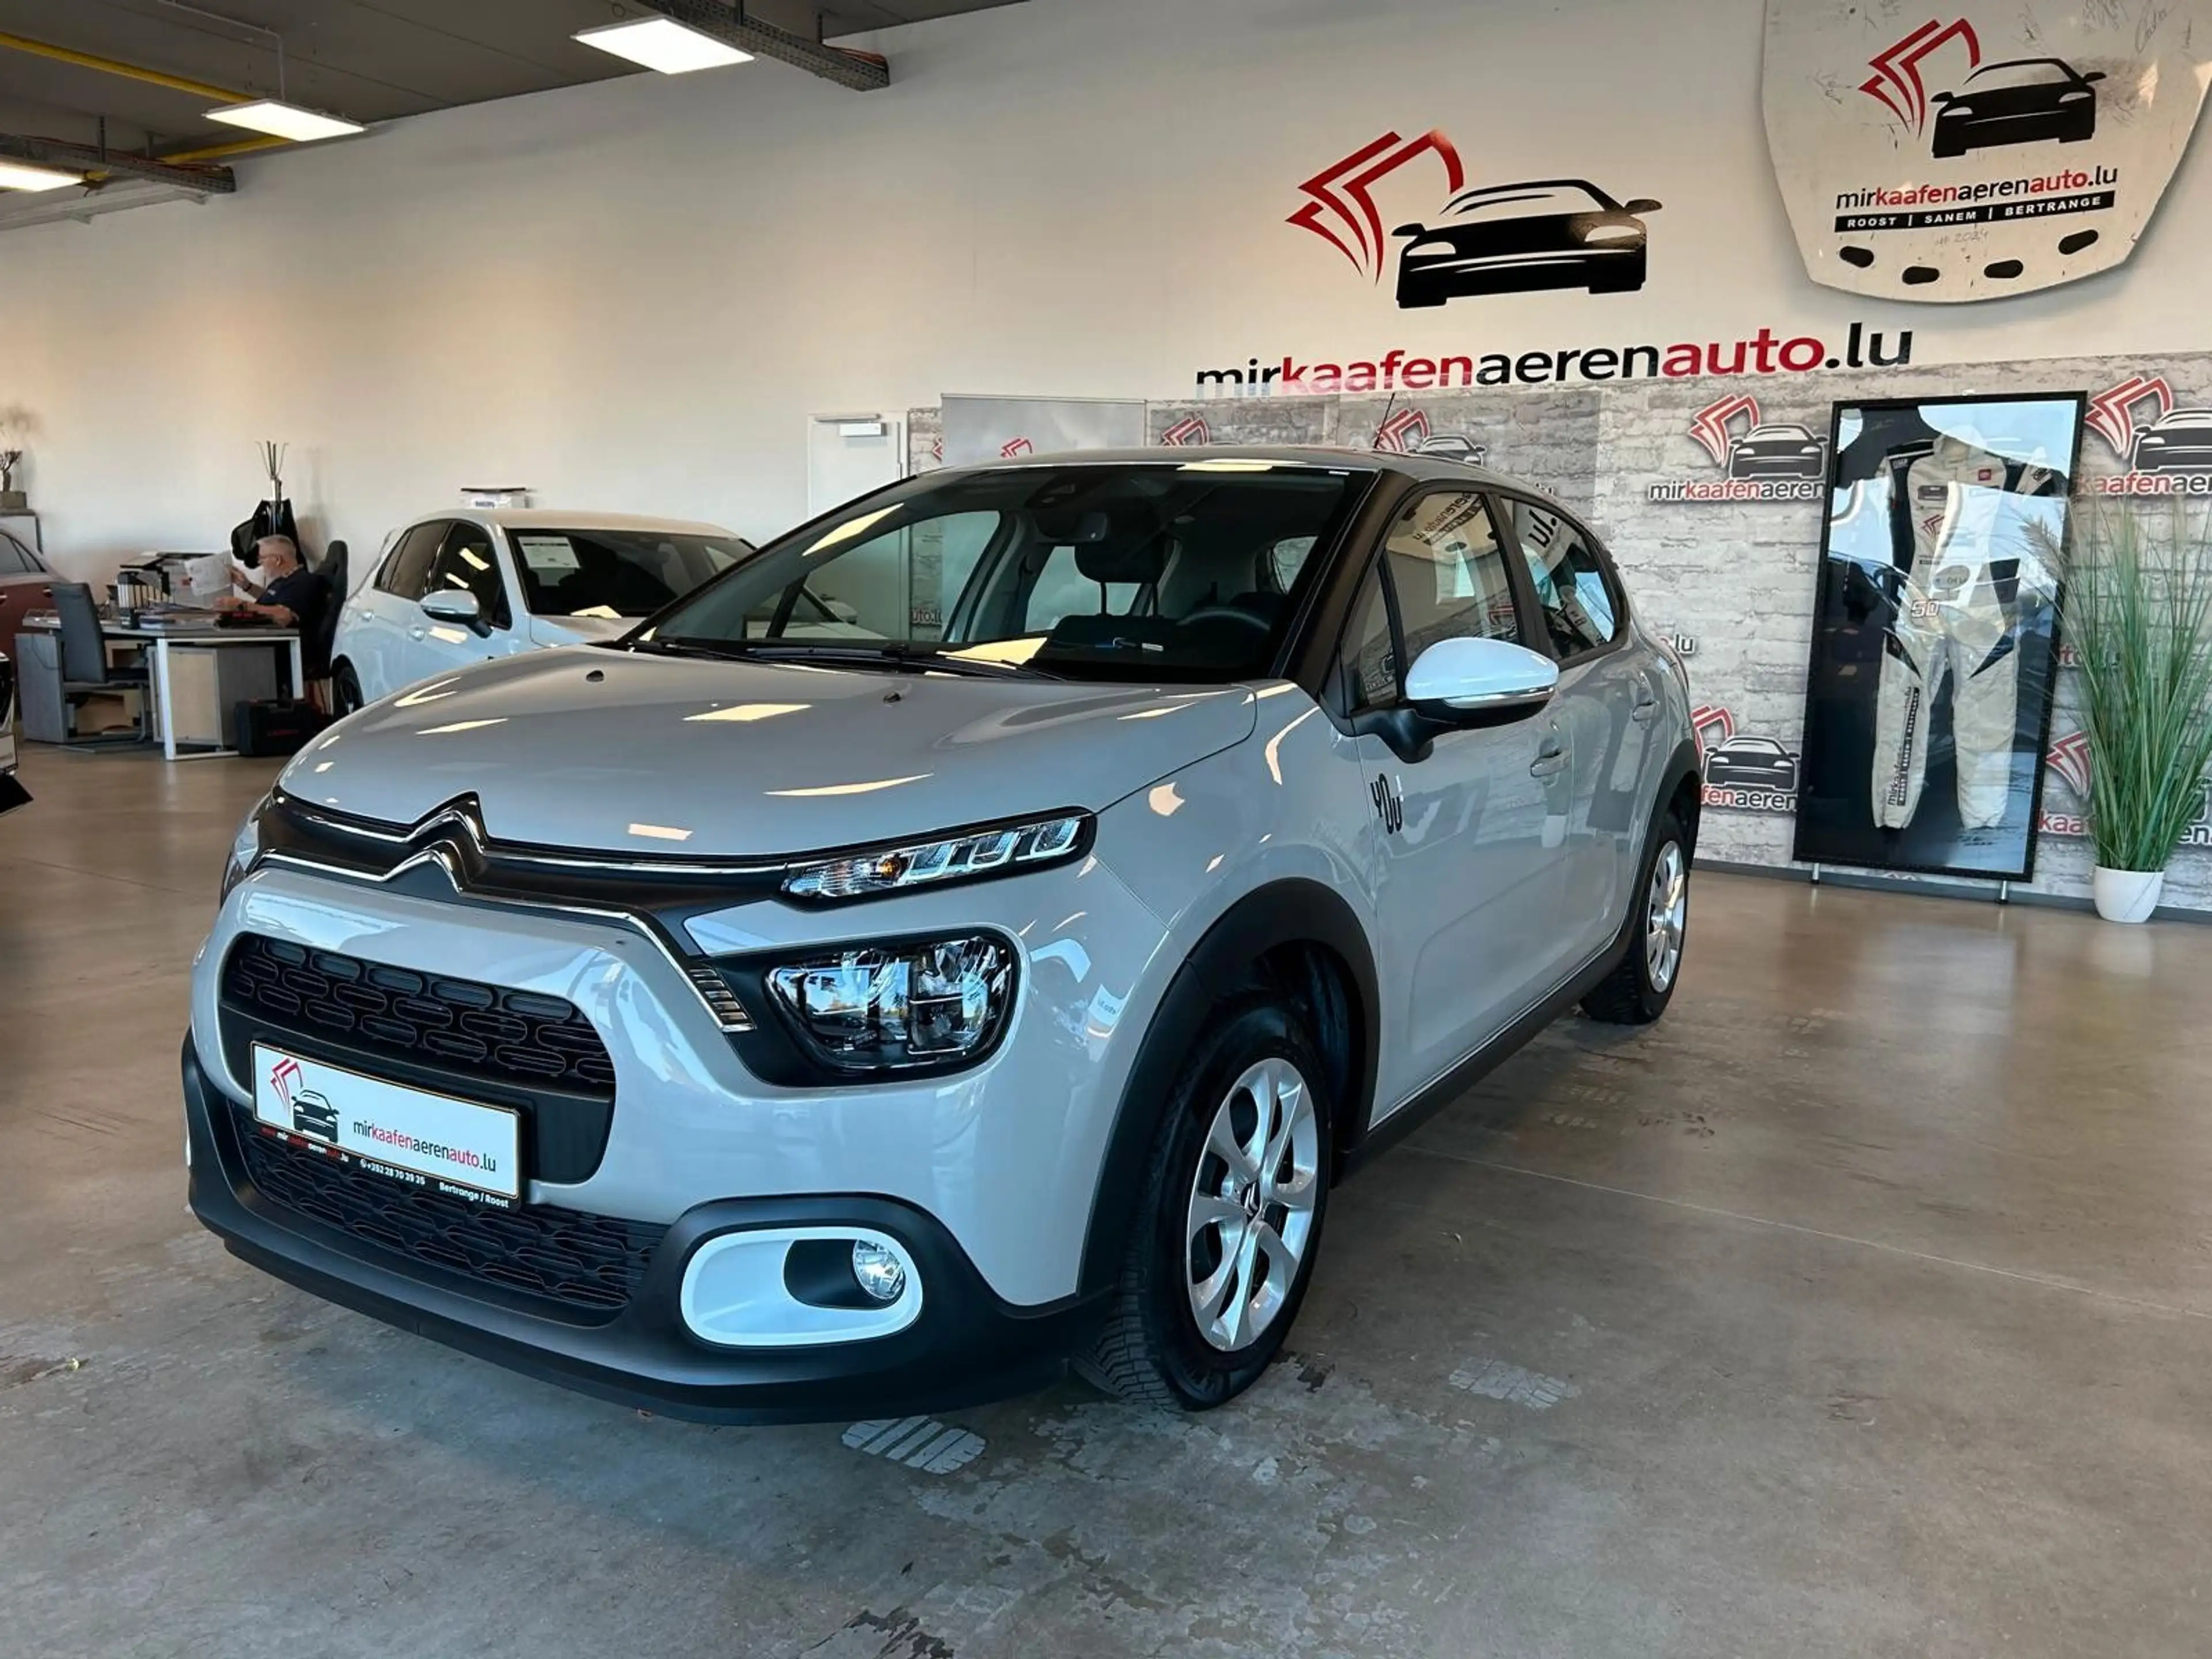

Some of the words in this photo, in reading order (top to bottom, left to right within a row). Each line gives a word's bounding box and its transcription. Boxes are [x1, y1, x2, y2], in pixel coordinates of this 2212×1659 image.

[1836, 165, 2118, 209] mirkaafenaerenauto.lu
[1847, 217, 1897, 228] ROOST
[1924, 210, 1977, 224] SANEM
[2005, 196, 2101, 217] BERTRANGE
[1196, 323, 1913, 397] mirkaafenaerenauto.lu
[353, 1119, 497, 1173] mirkaafenaerenauto.lu
[440, 1182, 479, 1202] Bertrange
[486, 1194, 509, 1209] Roost
